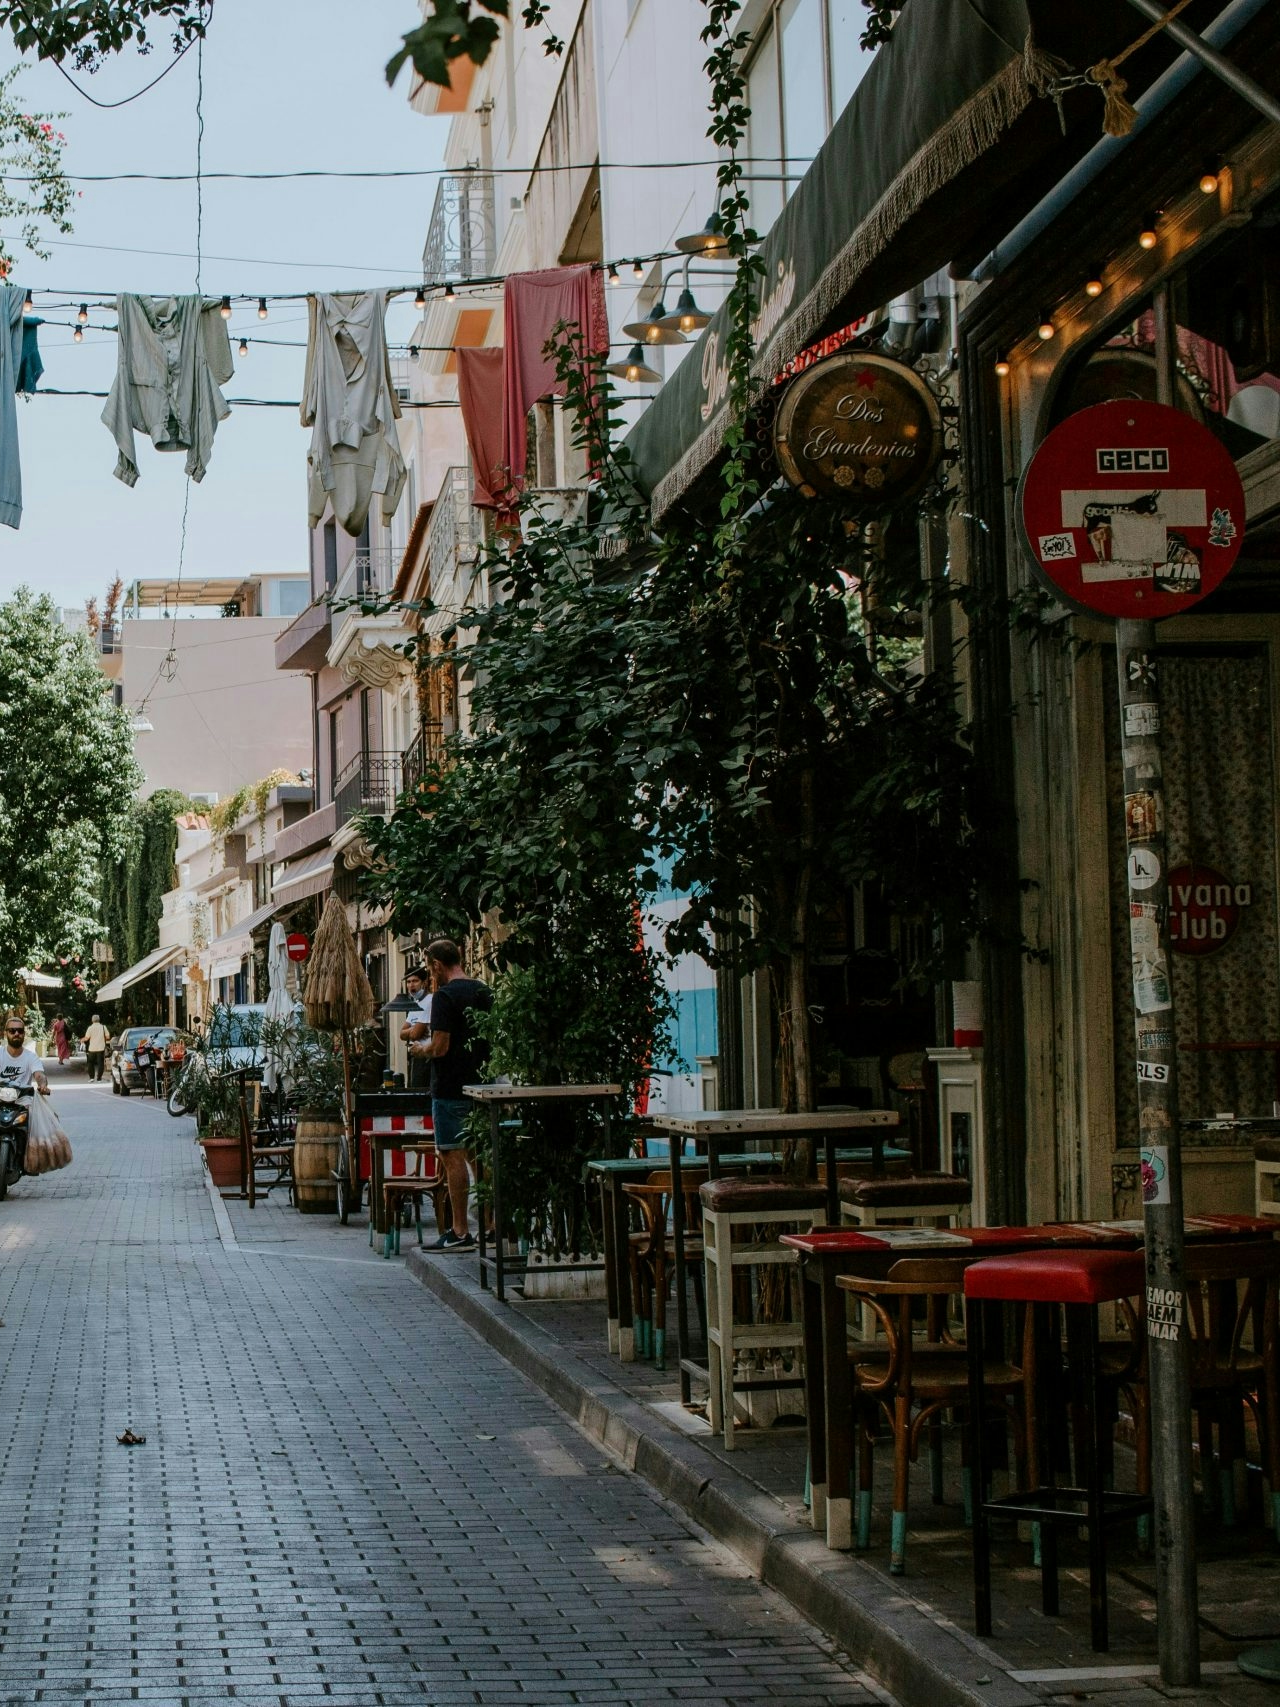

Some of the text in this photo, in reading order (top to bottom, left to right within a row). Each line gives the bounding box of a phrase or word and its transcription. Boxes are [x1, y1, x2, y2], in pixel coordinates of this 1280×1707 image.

[833, 394, 885, 424] Dos
[803, 425, 916, 461] Gardenias
[1168, 884, 1252, 907] vana
[4, 1065, 21, 1074] NIKE
[1146, 1286, 1183, 1307] EMOR
